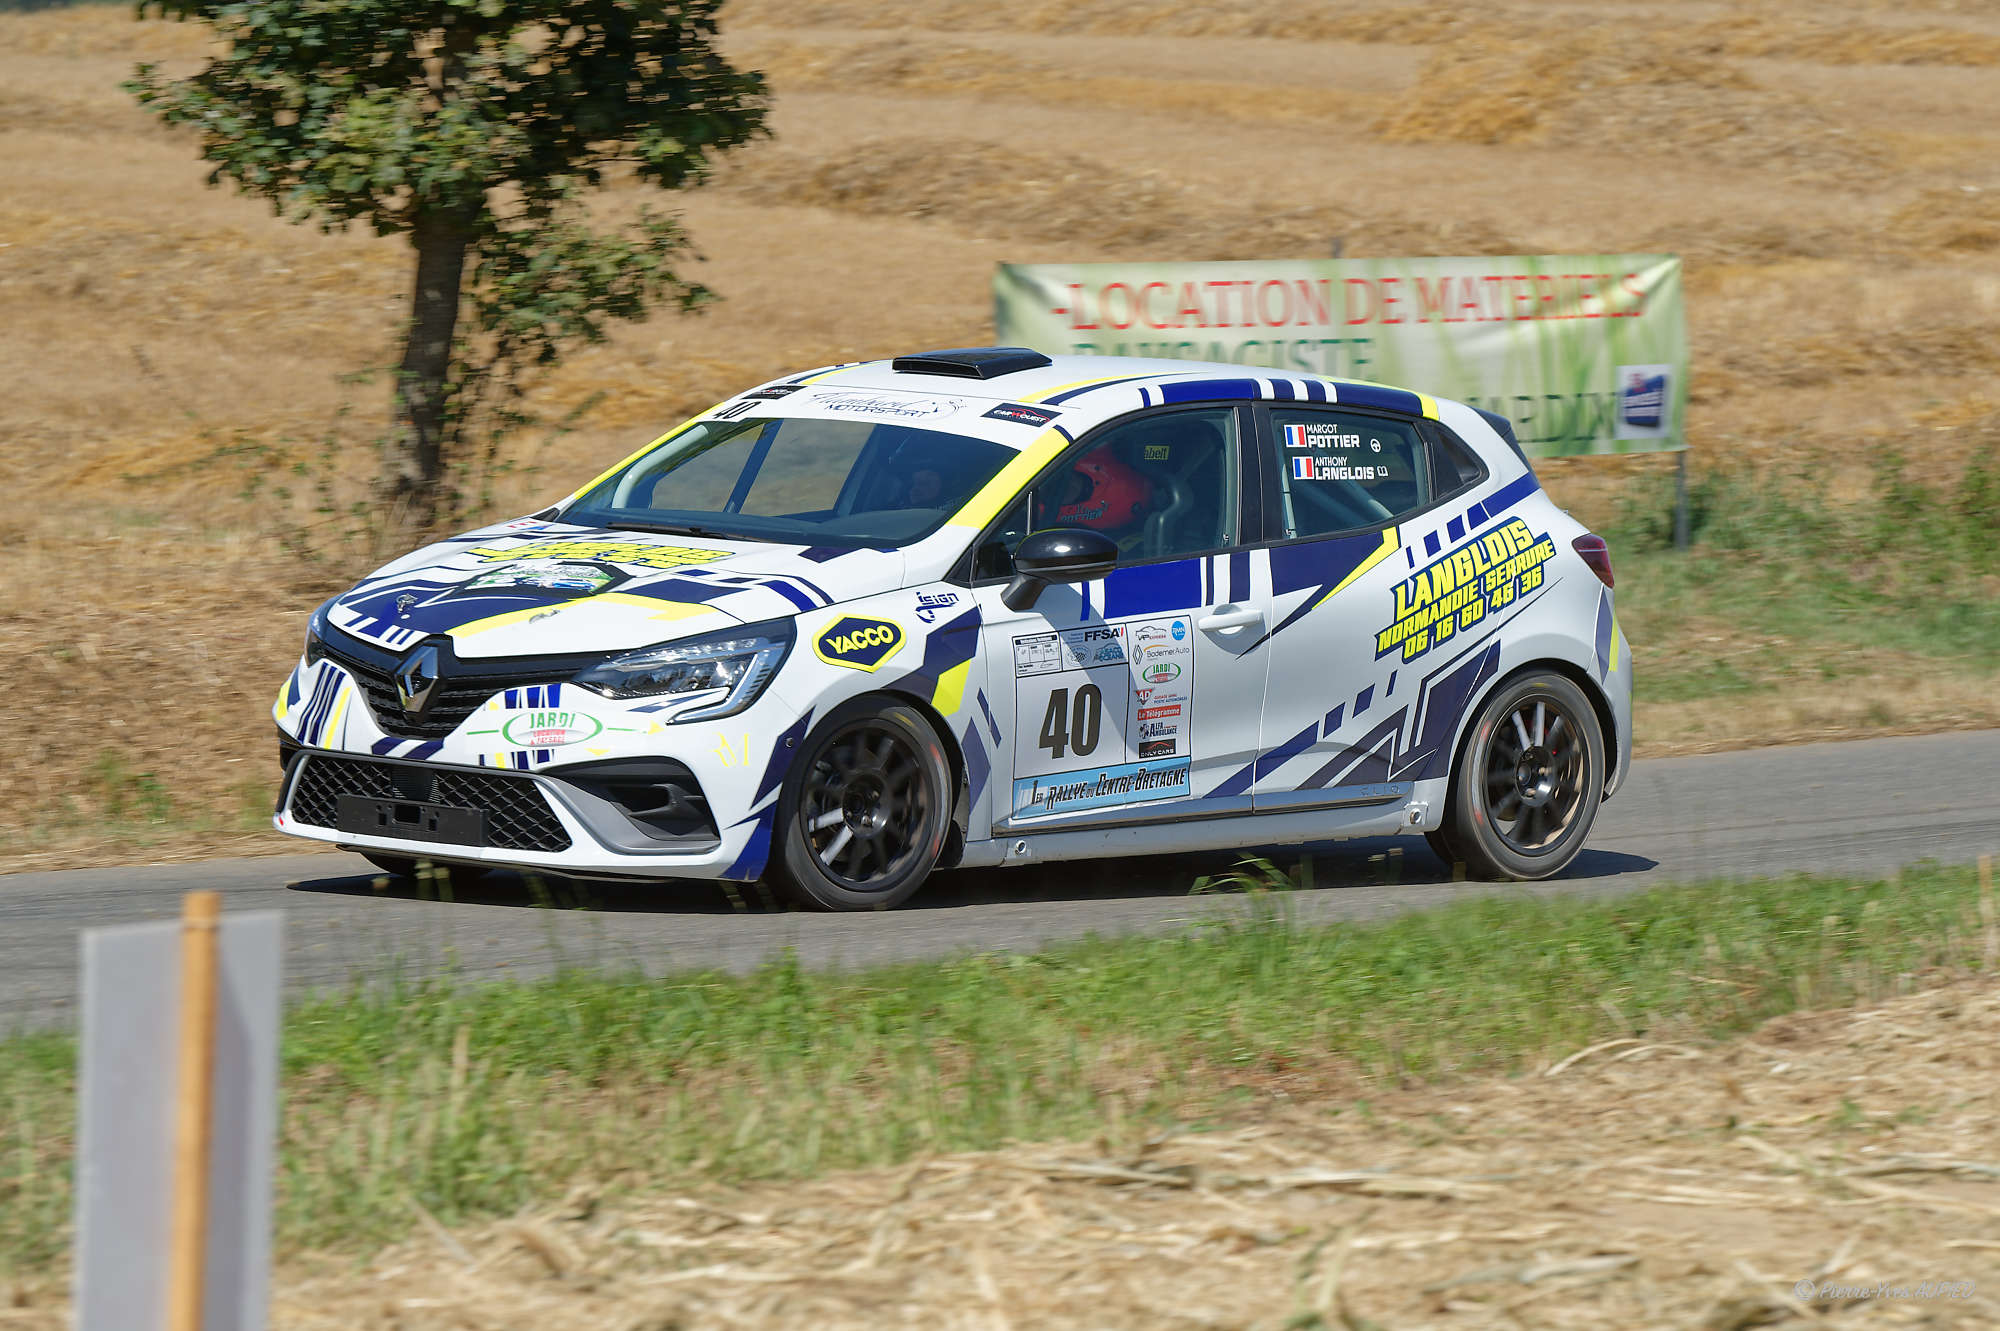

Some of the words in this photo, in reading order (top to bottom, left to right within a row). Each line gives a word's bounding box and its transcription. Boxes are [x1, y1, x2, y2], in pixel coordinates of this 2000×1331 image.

[1344, 277, 1402, 324] DE
[1306, 424, 1337, 434] MARGOT
[1308, 434, 1360, 448] POTTIER
[1144, 447, 1168, 459] abelt
[1315, 456, 1347, 466] ANTHONY
[1315, 466, 1374, 480] LANGLOIS
[1395, 519, 1534, 622] LANGLOIS
[1378, 580, 1480, 653] NORMANDIE
[1485, 539, 1555, 593] SERRURE
[1403, 629, 1430, 660] 06
[1434, 614, 1454, 643] 16
[1461, 601, 1484, 629] 60
[1490, 584, 1514, 609] 46
[1521, 568, 1543, 594] 36
[825, 624, 894, 655] YACCO
[1084, 628, 1120, 642] FFSA
[1039, 683, 1102, 760] 40
[1046, 782, 1089, 810] RALLYE
[1096, 768, 1187, 797] CENTRE-BRETAGNE
